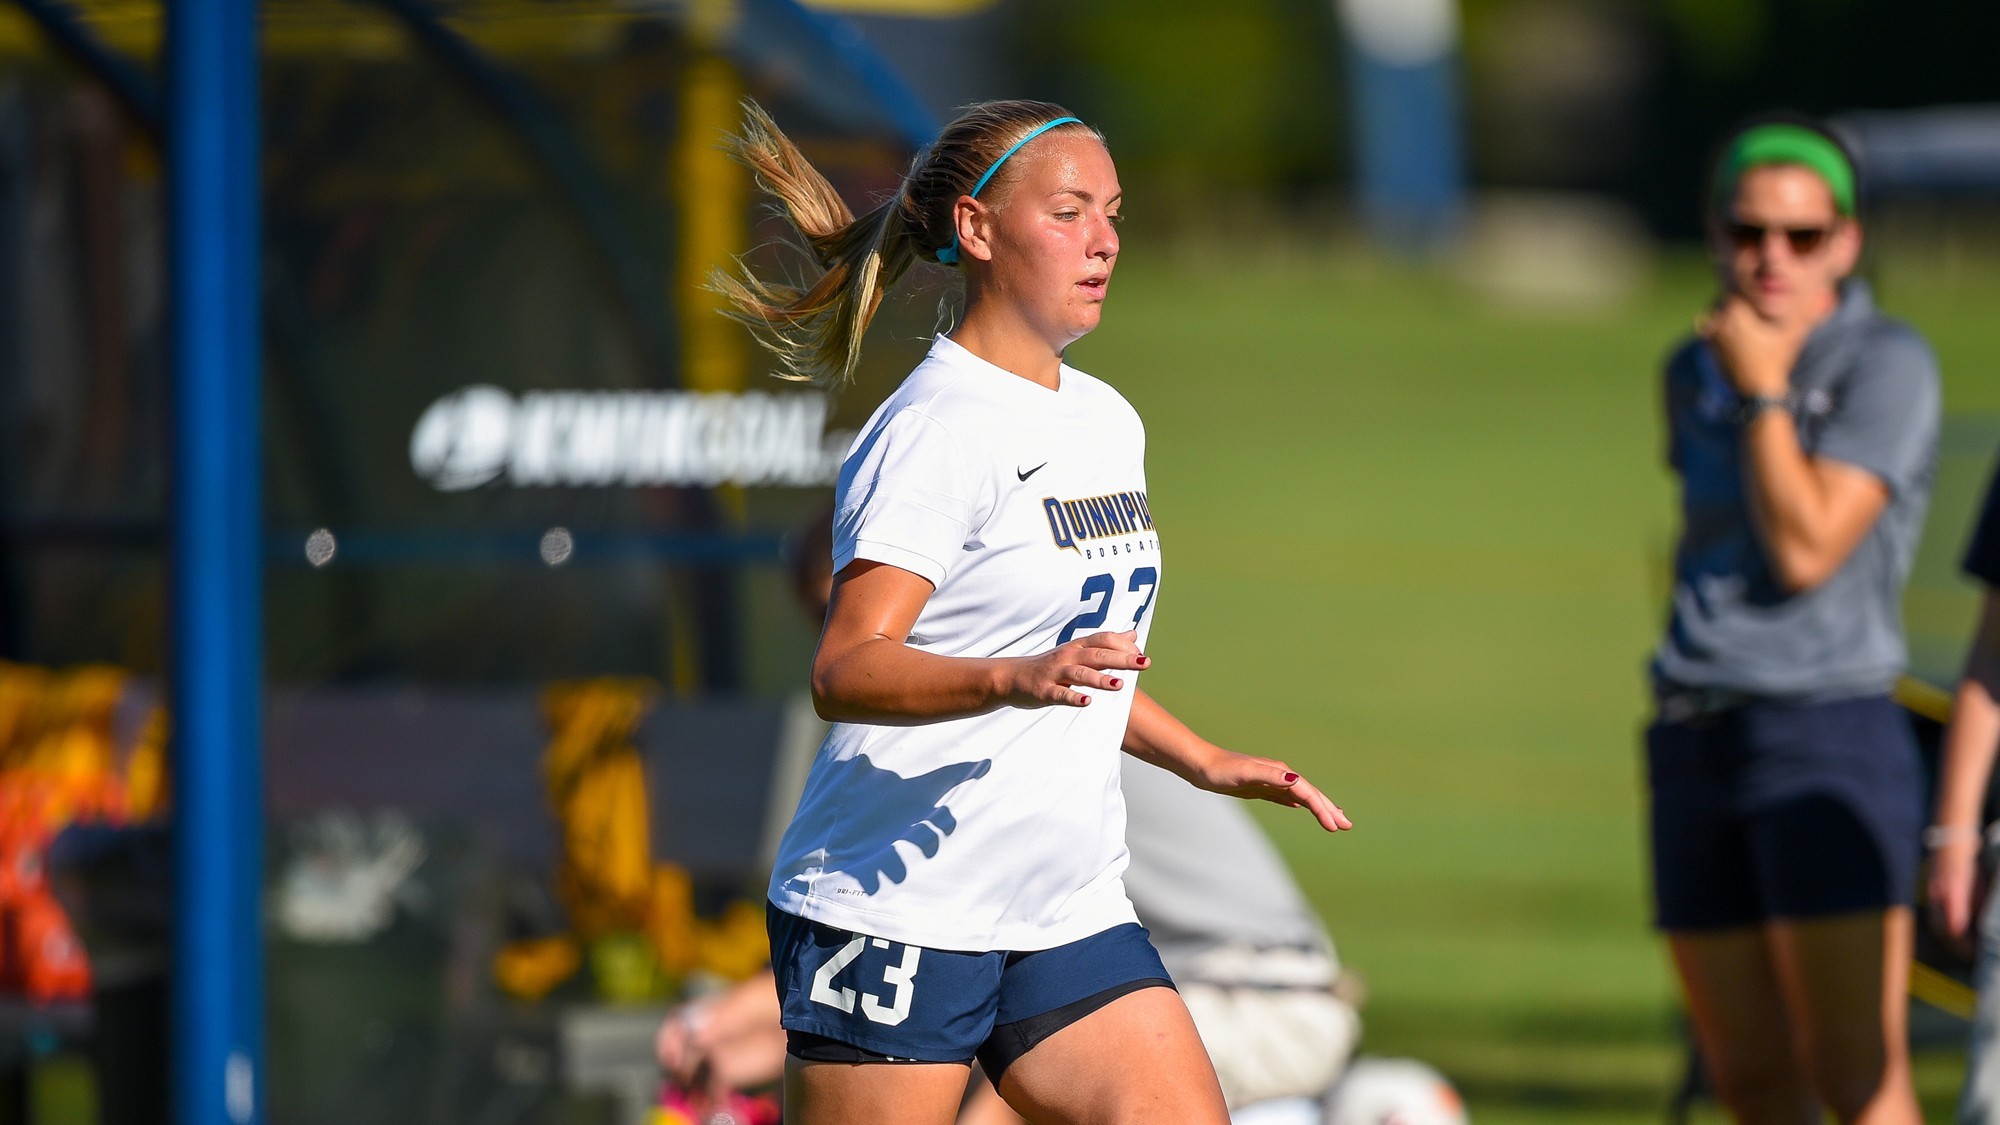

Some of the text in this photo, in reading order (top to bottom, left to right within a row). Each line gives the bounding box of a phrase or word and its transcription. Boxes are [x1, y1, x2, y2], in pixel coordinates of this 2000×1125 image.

[1042, 490, 1156, 556] QUINNIPIA
[1056, 567, 1158, 647] 23
[810, 925, 921, 1027] 23
